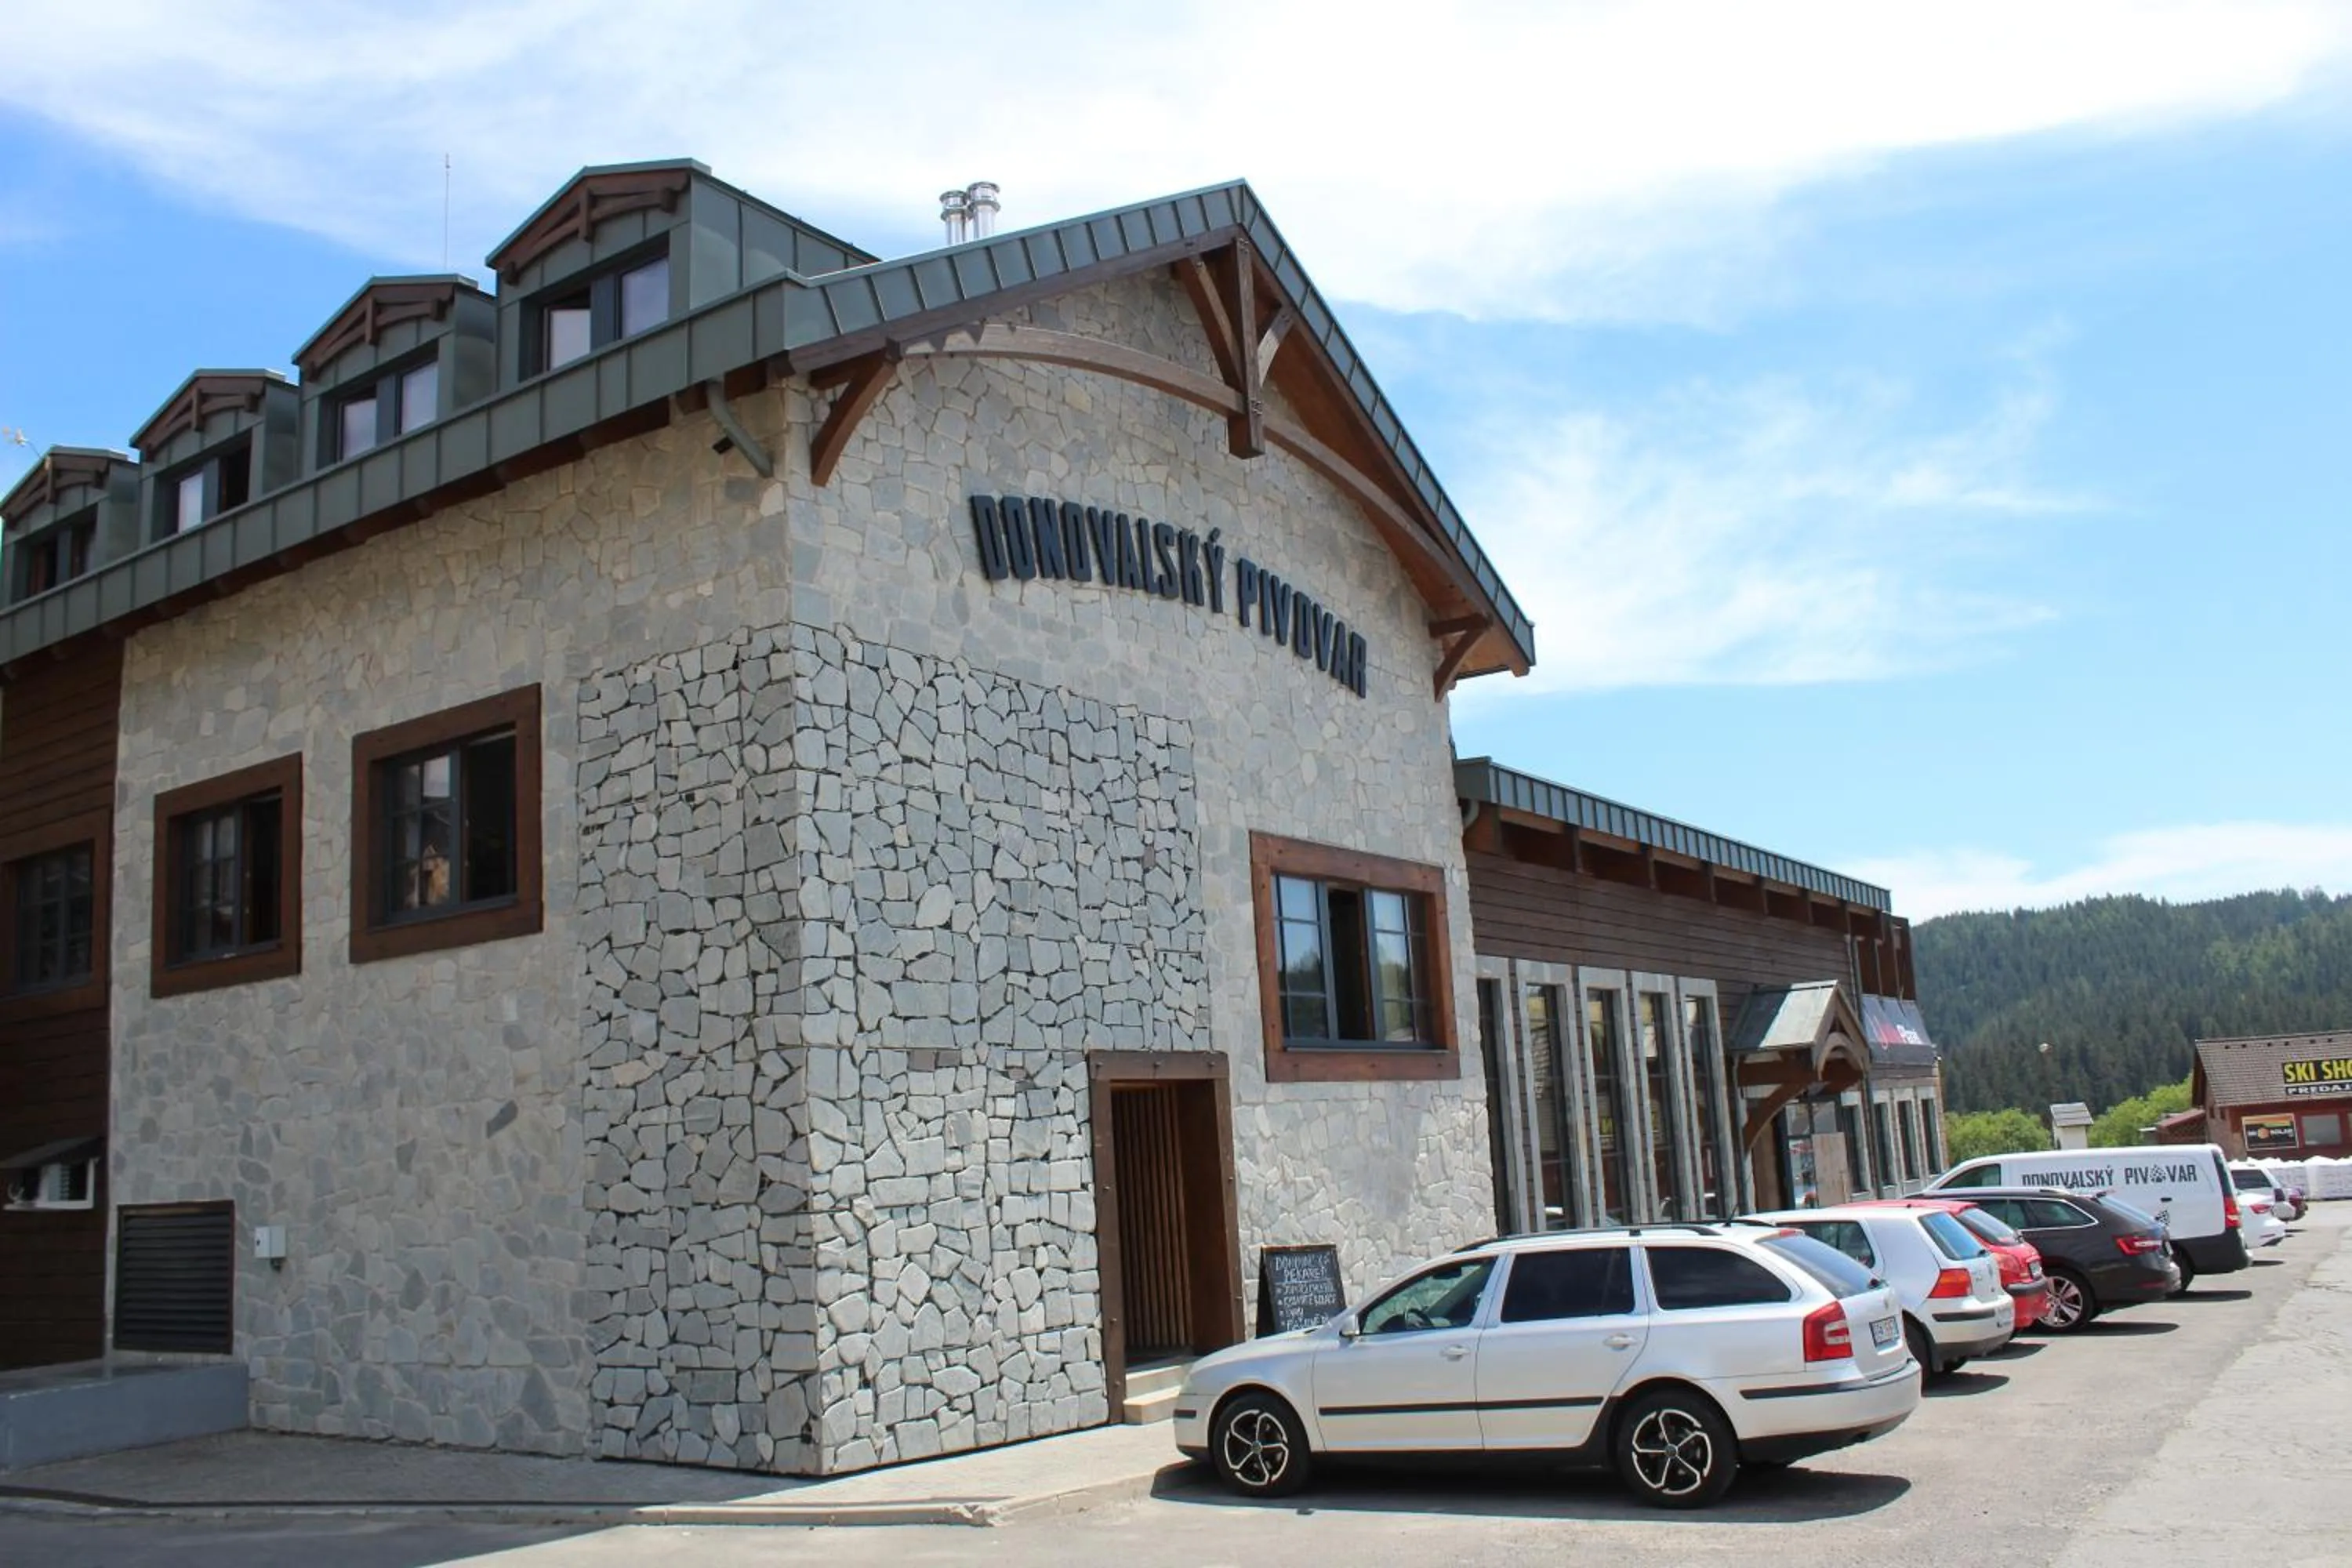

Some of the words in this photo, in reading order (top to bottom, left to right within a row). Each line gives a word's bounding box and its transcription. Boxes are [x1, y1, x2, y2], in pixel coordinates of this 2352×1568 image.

[971, 495, 1225, 613] DONOVALSKÝ
[1237, 557, 1367, 699] PIVOVAR
[2284, 1062, 2316, 1083] SKI
